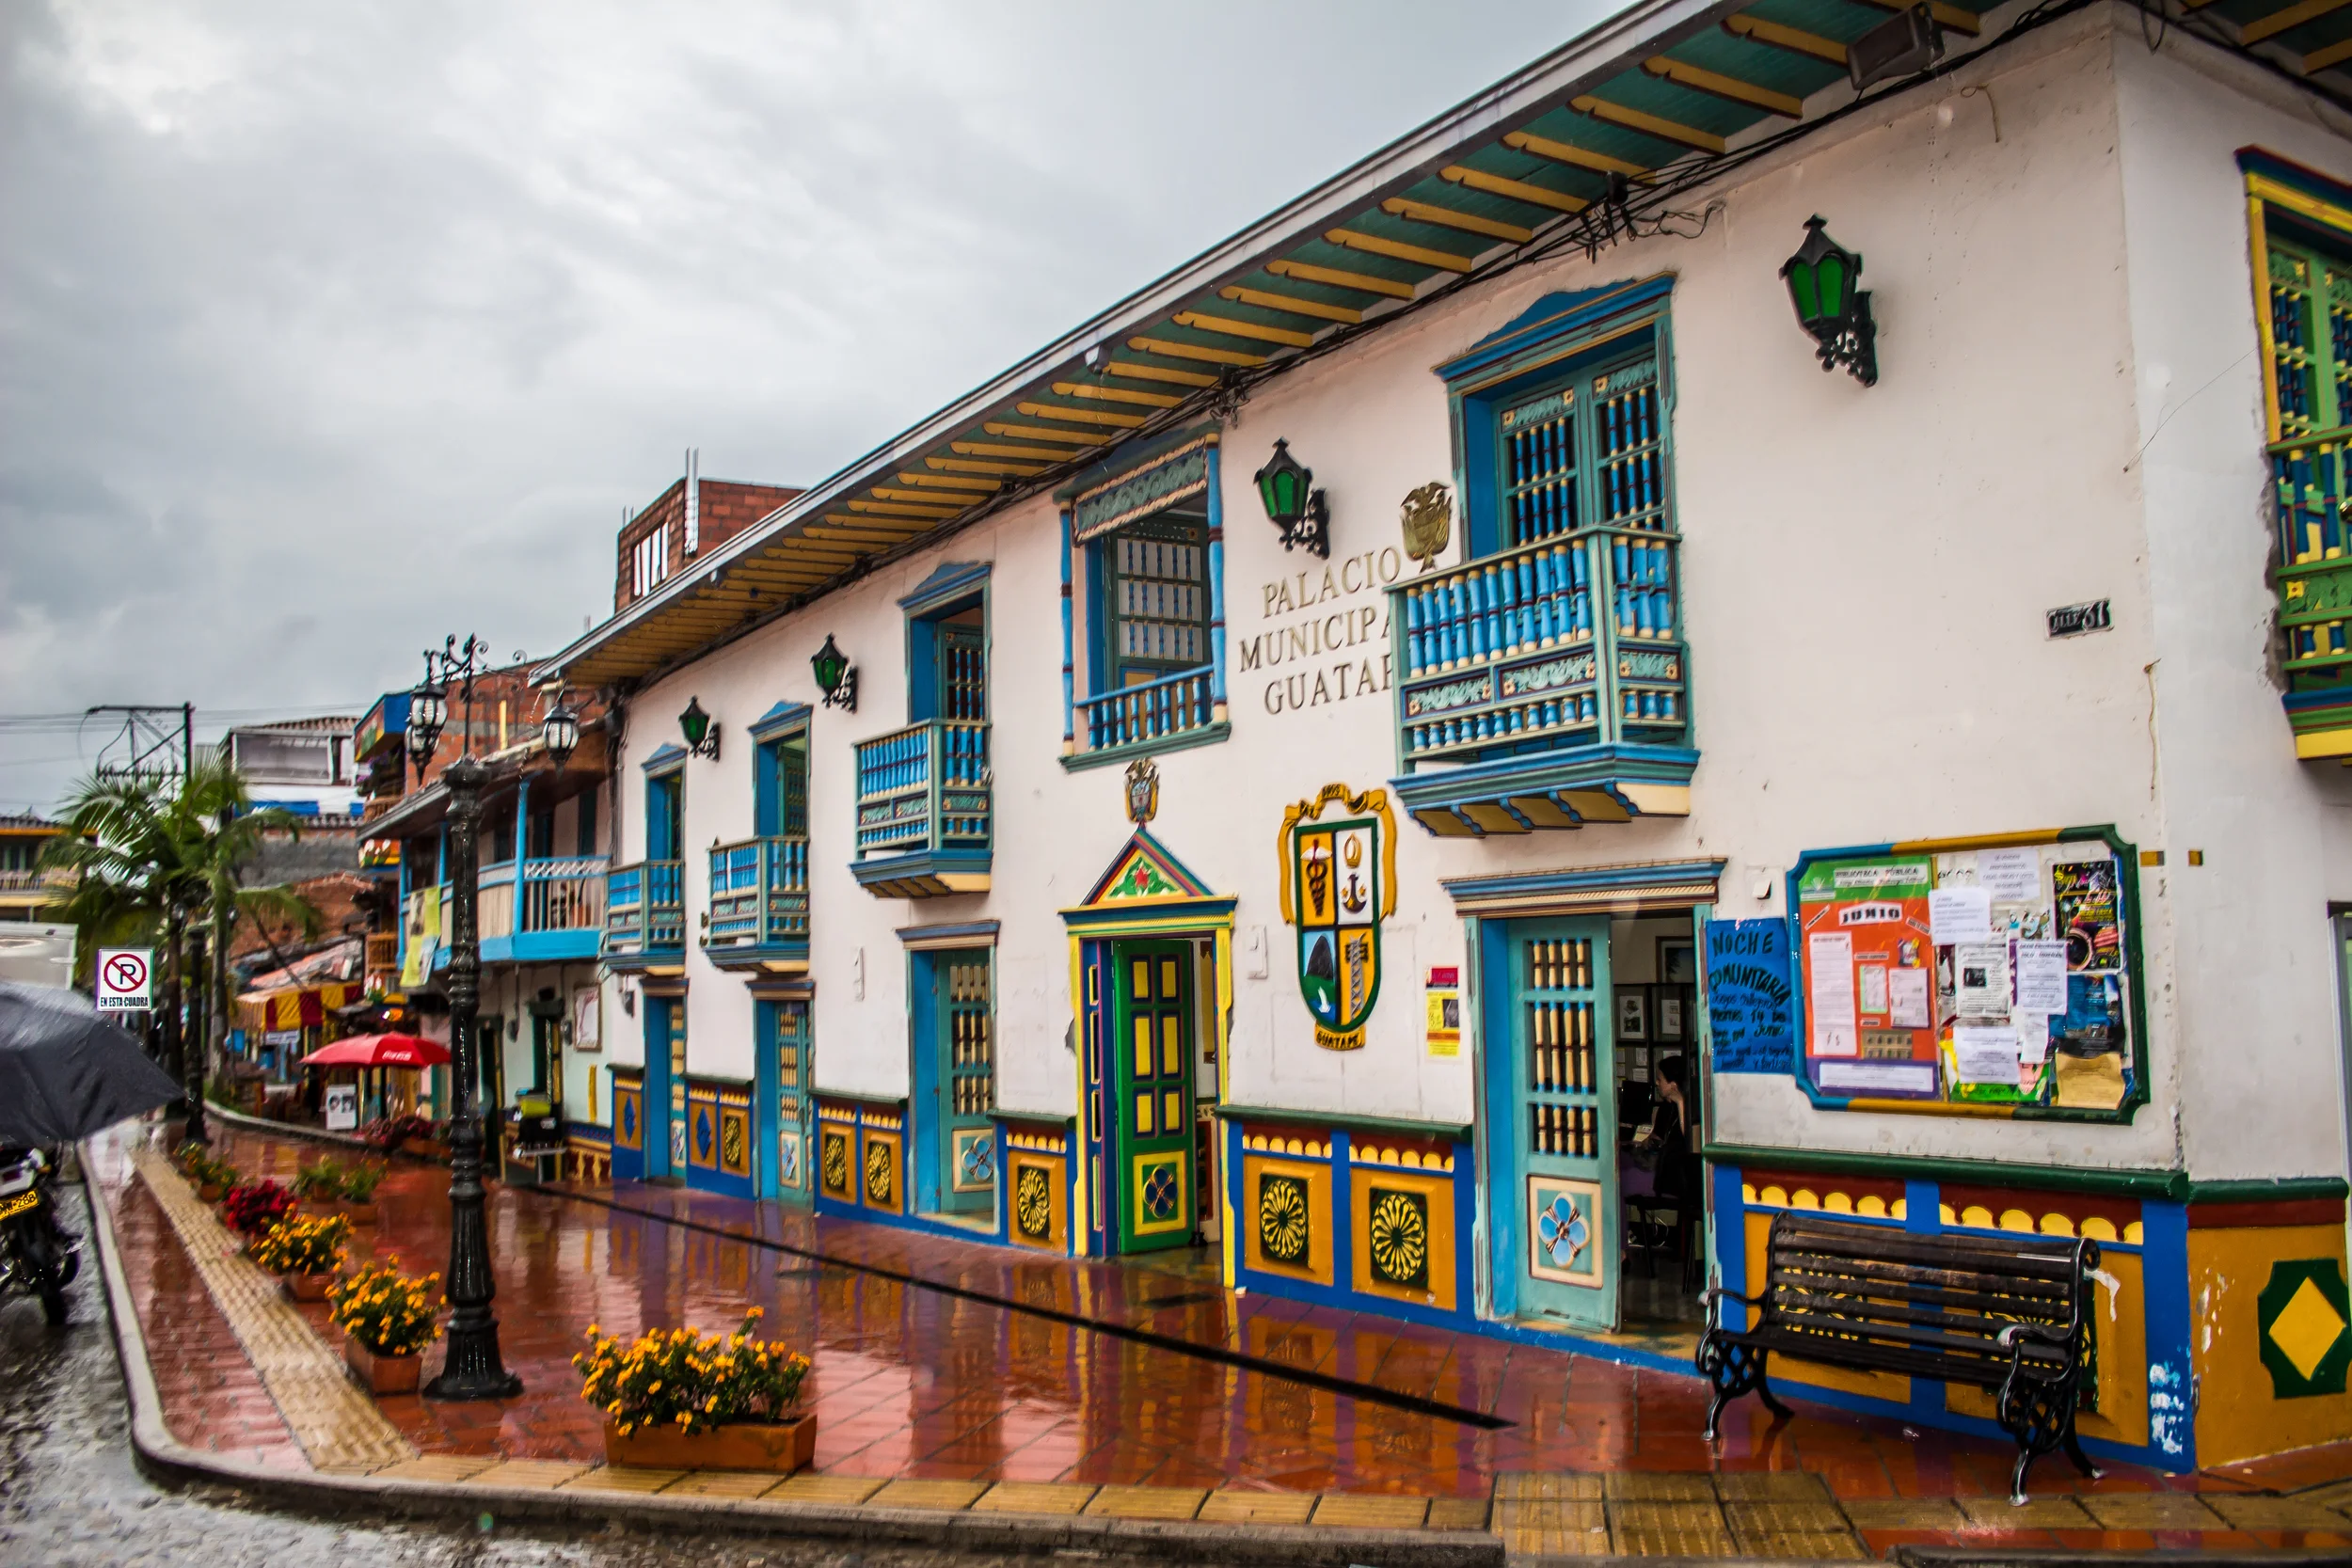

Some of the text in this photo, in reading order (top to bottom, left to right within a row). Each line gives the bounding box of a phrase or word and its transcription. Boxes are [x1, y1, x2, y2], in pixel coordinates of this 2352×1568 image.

[1262, 547, 1401, 619] PALACIO
[1841, 908, 1900, 925] JUNIO
[1712, 931, 1773, 957] NOCHE
[101, 997, 148, 1006] EN ESTA CUADRA
